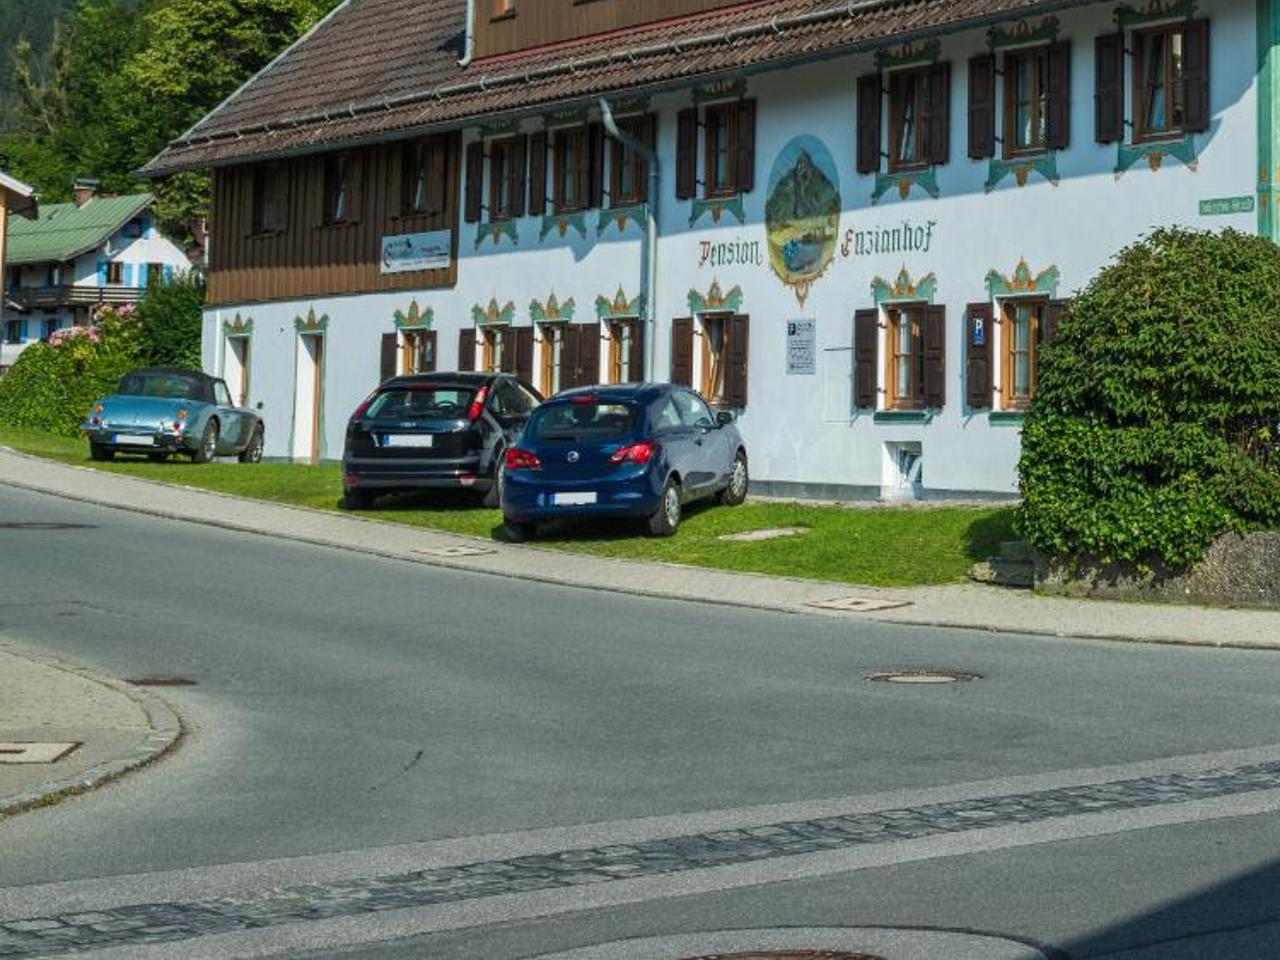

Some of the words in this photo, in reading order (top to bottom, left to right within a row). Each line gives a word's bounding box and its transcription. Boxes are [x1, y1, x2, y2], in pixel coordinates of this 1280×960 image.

[697, 236, 763, 267] Pension
[841, 219, 937, 258] Enzianhof
[975, 318, 984, 337] P
